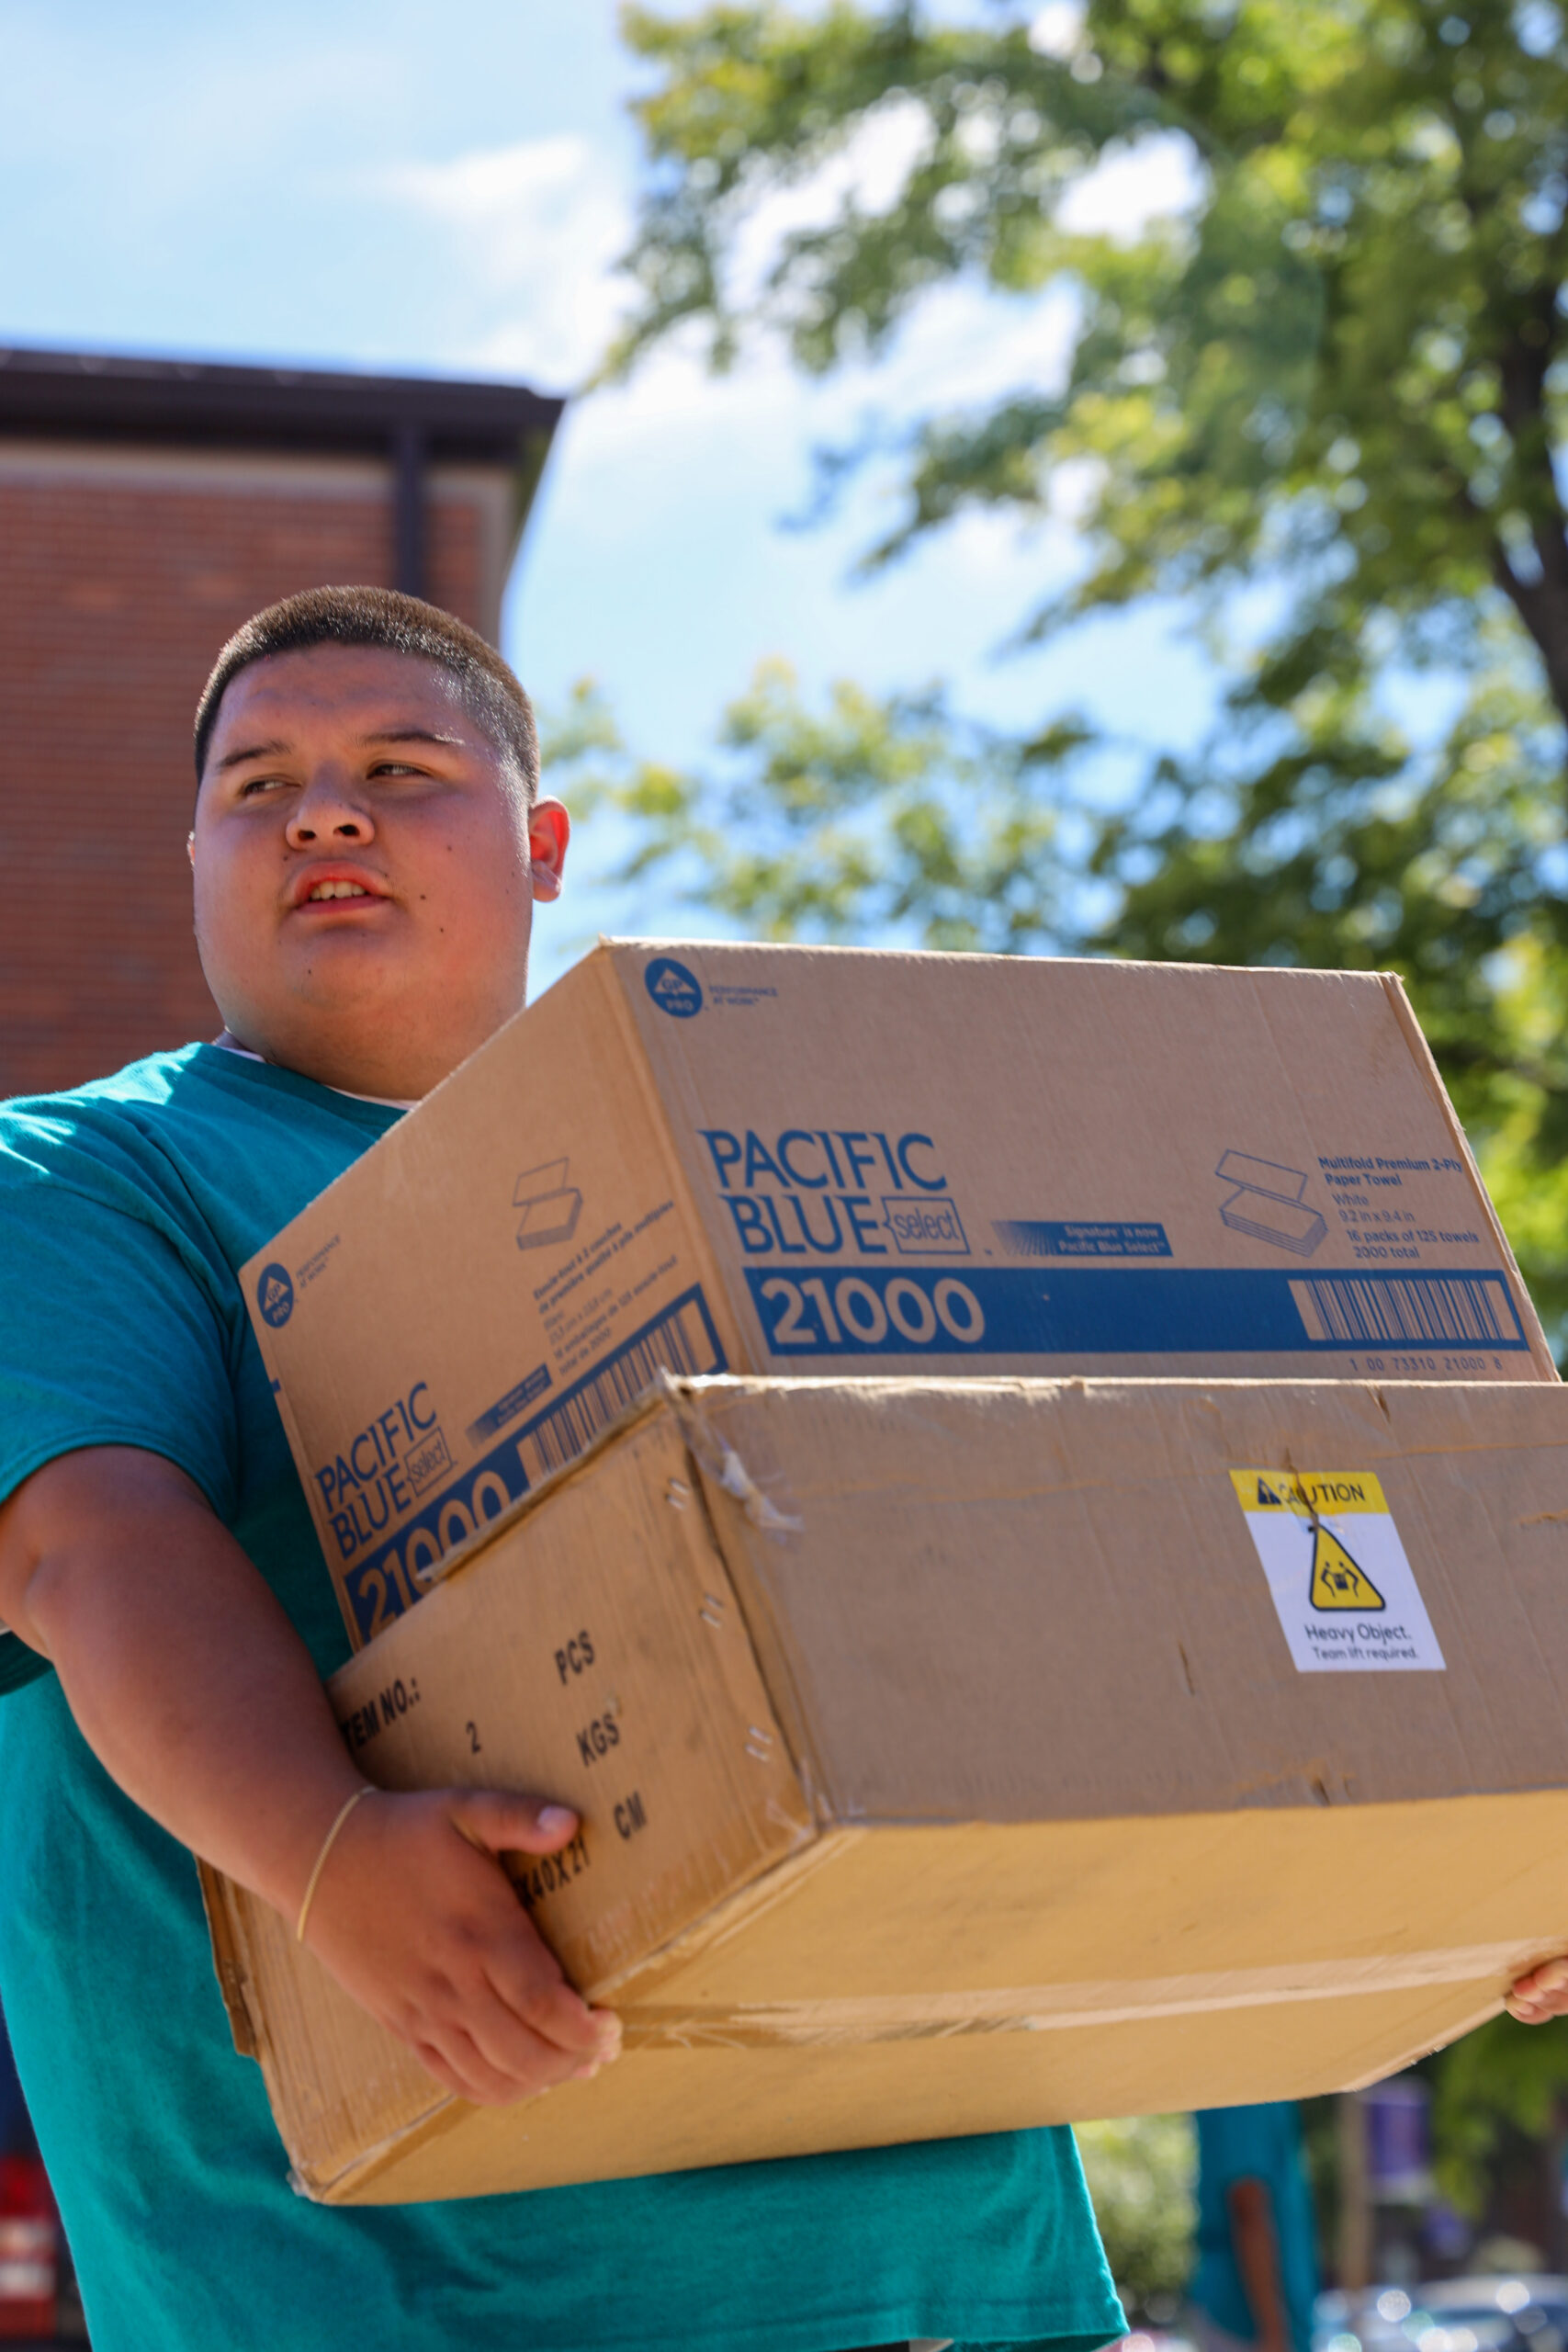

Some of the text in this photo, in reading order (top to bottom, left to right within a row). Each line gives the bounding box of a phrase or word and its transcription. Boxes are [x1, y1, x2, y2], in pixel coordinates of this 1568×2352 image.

[696, 1128, 948, 1192] PACIFIC
[1317, 1157, 1463, 1173] Multifold Premium 2-Ply
[1324, 1173, 1403, 1187] Paper Towel
[1331, 1193, 1369, 1206] White
[718, 1194, 960, 1254] BLUE select
[1338, 1209, 1416, 1223] 9.2 in x 9.4 in
[1134, 1227, 1158, 1238] now
[1346, 1229, 1480, 1243] 16 packs of 125 towels
[1058, 1240, 1097, 1253] Pacific
[1098, 1241, 1122, 1253] Blue
[1353, 1246, 1420, 1259] 2000 total
[761, 1276, 985, 1344] 21000
[1366, 1357, 1385, 1371] 00
[314, 1382, 437, 1513] PACIFIC
[328, 1439, 446, 1560] BLUE select
[1303, 1623, 1412, 1645] Heavy Object.
[1311, 1646, 1348, 1660] Team
[1348, 1646, 1365, 1659] lift
[465, 1630, 596, 1755] 2 PCS
[576, 1713, 621, 1768] KGS
[613, 1792, 648, 1843] CM
